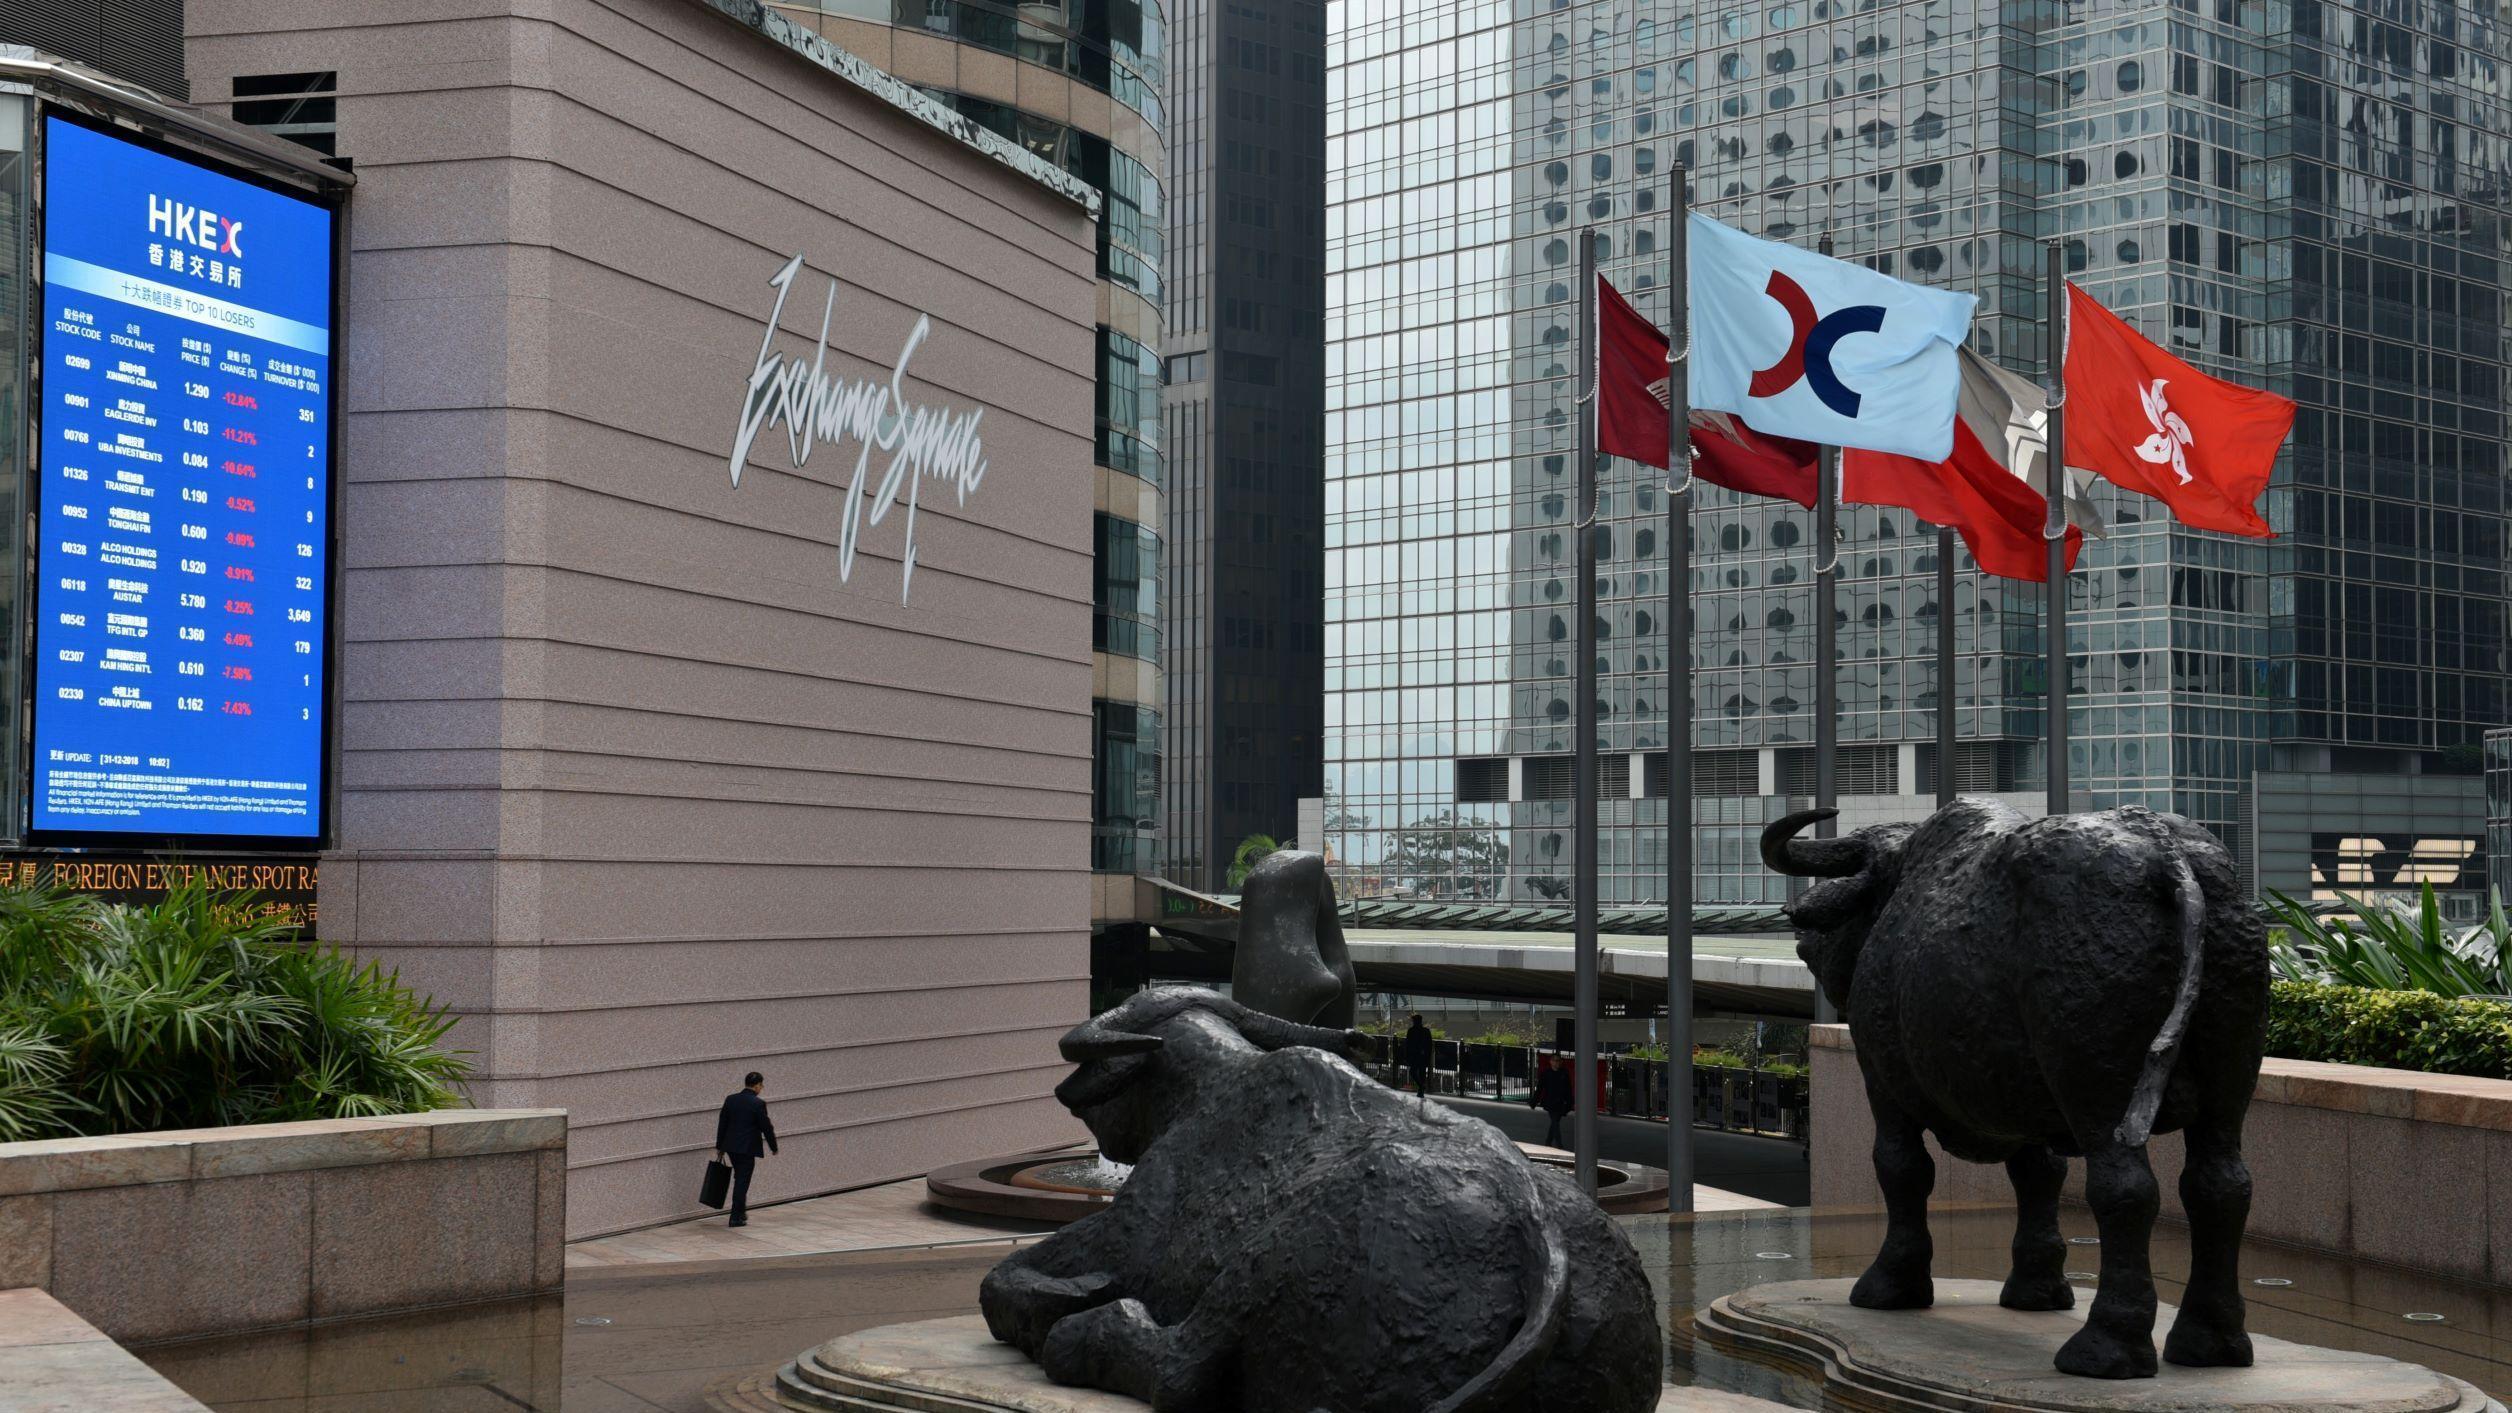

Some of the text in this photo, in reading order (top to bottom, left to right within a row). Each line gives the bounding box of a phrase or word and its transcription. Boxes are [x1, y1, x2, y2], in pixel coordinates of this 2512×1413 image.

[149, 194, 242, 259] HKEX
[149, 243, 242, 289] 香港交易所
[185, 299, 205, 314] TOP
[208, 306, 218, 319] 10
[220, 309, 255, 329] LOSERS
[55, 321, 102, 340] STOCK CODE
[126, 324, 140, 337] 公司
[110, 334, 155, 353] STOCK NAME
[65, 355, 90, 370] 02699
[181, 352, 200, 364] PRICE
[220, 362, 246, 377] CHANGE
[106, 370, 158, 390] XINMING CHINA
[264, 372, 296, 389] TURNOVER
[184, 382, 210, 399] 1.290
[64, 393, 89, 408] 00901
[104, 408, 157, 428] EAGLERIDE INV
[299, 409, 314, 423] 351
[183, 418, 209, 435] 0.103
[64, 429, 89, 444] 00768
[98, 442, 163, 463] UBA INVESTMENTS
[308, 446, 315, 458] 2
[183, 452, 208, 468] 0.084
[63, 466, 89, 481] 01326
[307, 477, 314, 489] 8
[141, 487, 155, 498] ENT
[182, 488, 208, 504] 0.190
[62, 505, 88, 519] 00952
[307, 511, 313, 523] 9
[108, 518, 151, 534] TONGHAI FIN
[182, 524, 207, 540] 0.600
[61, 542, 87, 556] 00328
[101, 541, 157, 559] ALCO HOLDINGS
[297, 544, 313, 557] 126
[100, 553, 157, 570] ALCO HOLDINGS
[181, 559, 207, 574] 0.920
[61, 578, 87, 592] 06118
[296, 577, 312, 590] 322
[113, 591, 143, 604] AUSTAR
[180, 594, 206, 609] 5.780
[60, 613, 86, 627] 00542
[288, 608, 311, 623] 3,649
[107, 625, 121, 635] TFG
[138, 629, 149, 638] GP
[180, 627, 205, 642] 0.360
[295, 641, 311, 654] 179
[59, 649, 85, 662] 02307
[99, 660, 117, 671] KAM
[117, 662, 135, 672] HING
[179, 661, 204, 676] 0.610
[304, 674, 309, 687] 1
[58, 687, 84, 700] 02330
[98, 697, 153, 711] CHINA UPTOWN
[178, 697, 204, 711] 0.162
[302, 708, 309, 720] 3
[54, 863, 140, 889] FOREIGN
[252, 865, 294, 890] SPOT
